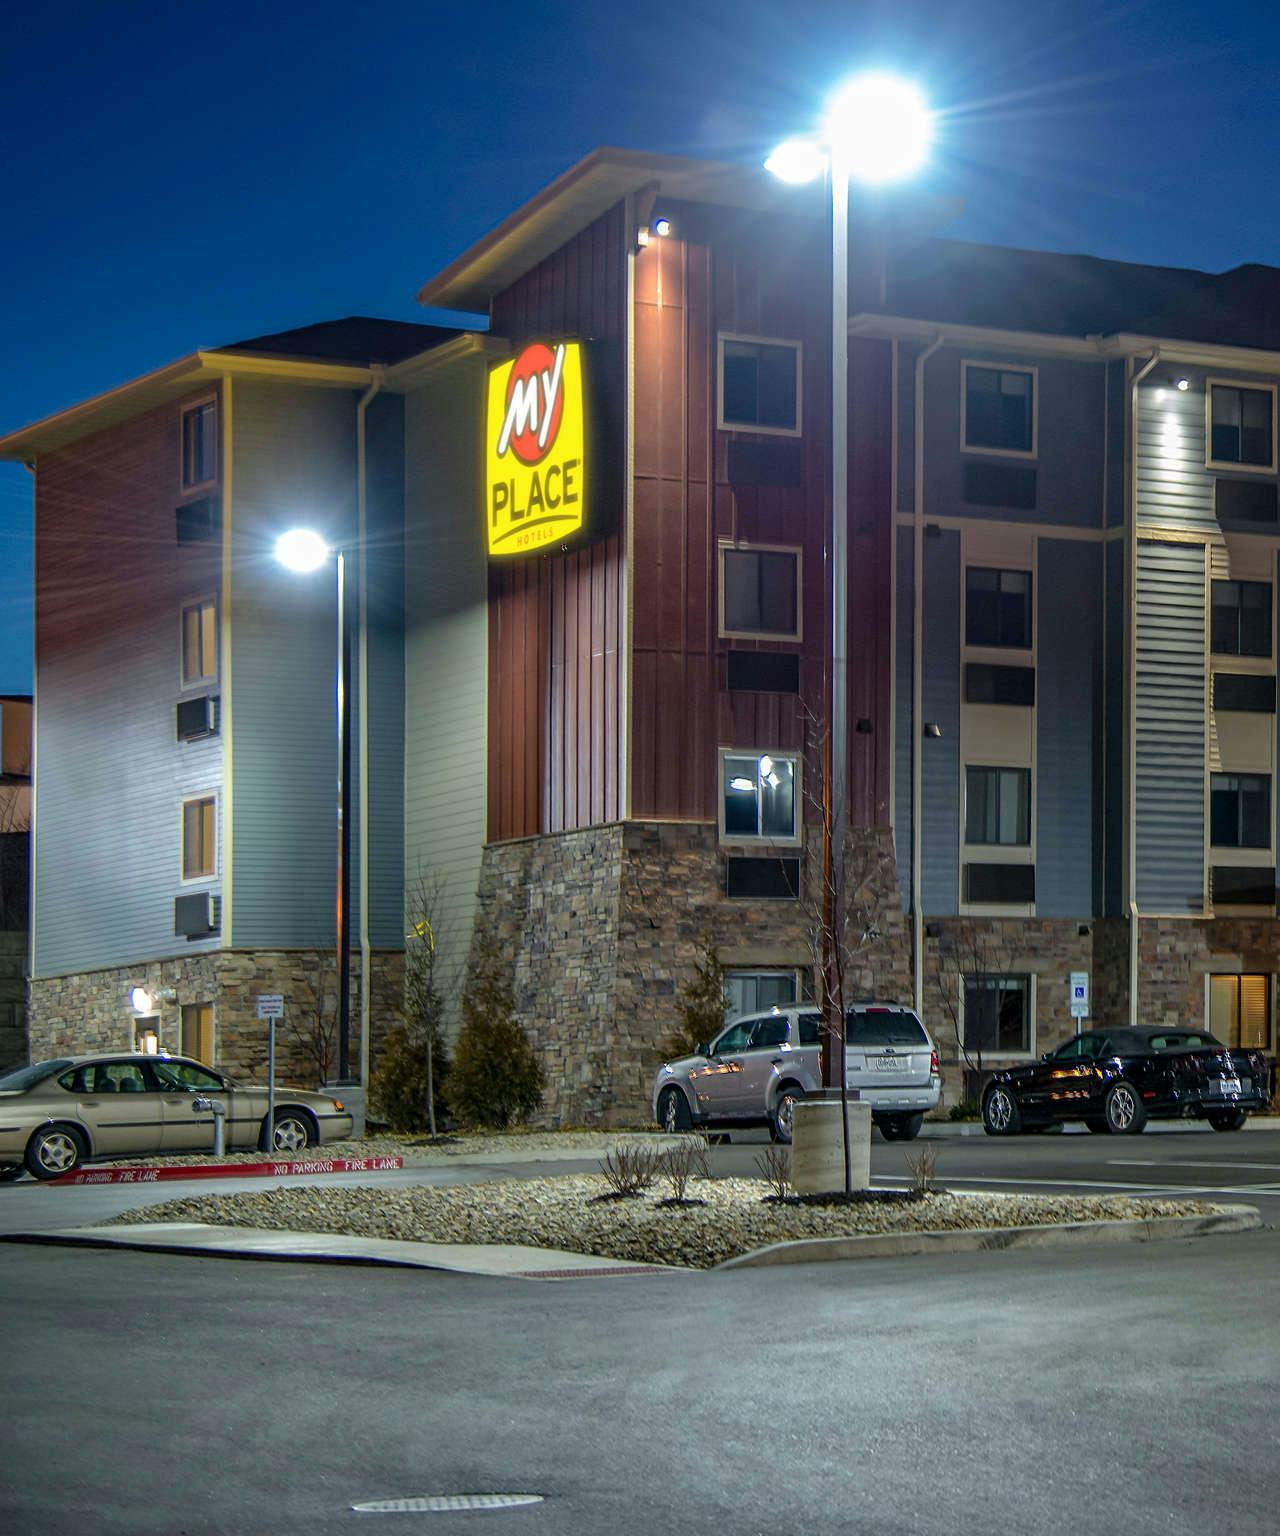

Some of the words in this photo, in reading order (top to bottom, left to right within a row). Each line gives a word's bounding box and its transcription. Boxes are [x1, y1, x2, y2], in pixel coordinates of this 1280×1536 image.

[492, 458, 579, 527] PLACE
[516, 526, 554, 547] HOTELS
[119, 1171, 137, 1182] FIRE
[138, 1169, 160, 1181] LANE
[274, 1164, 288, 1176] NO
[292, 1161, 334, 1174] PARKING
[344, 1160, 368, 1171] FIRE
[373, 1159, 400, 1170] LANE
